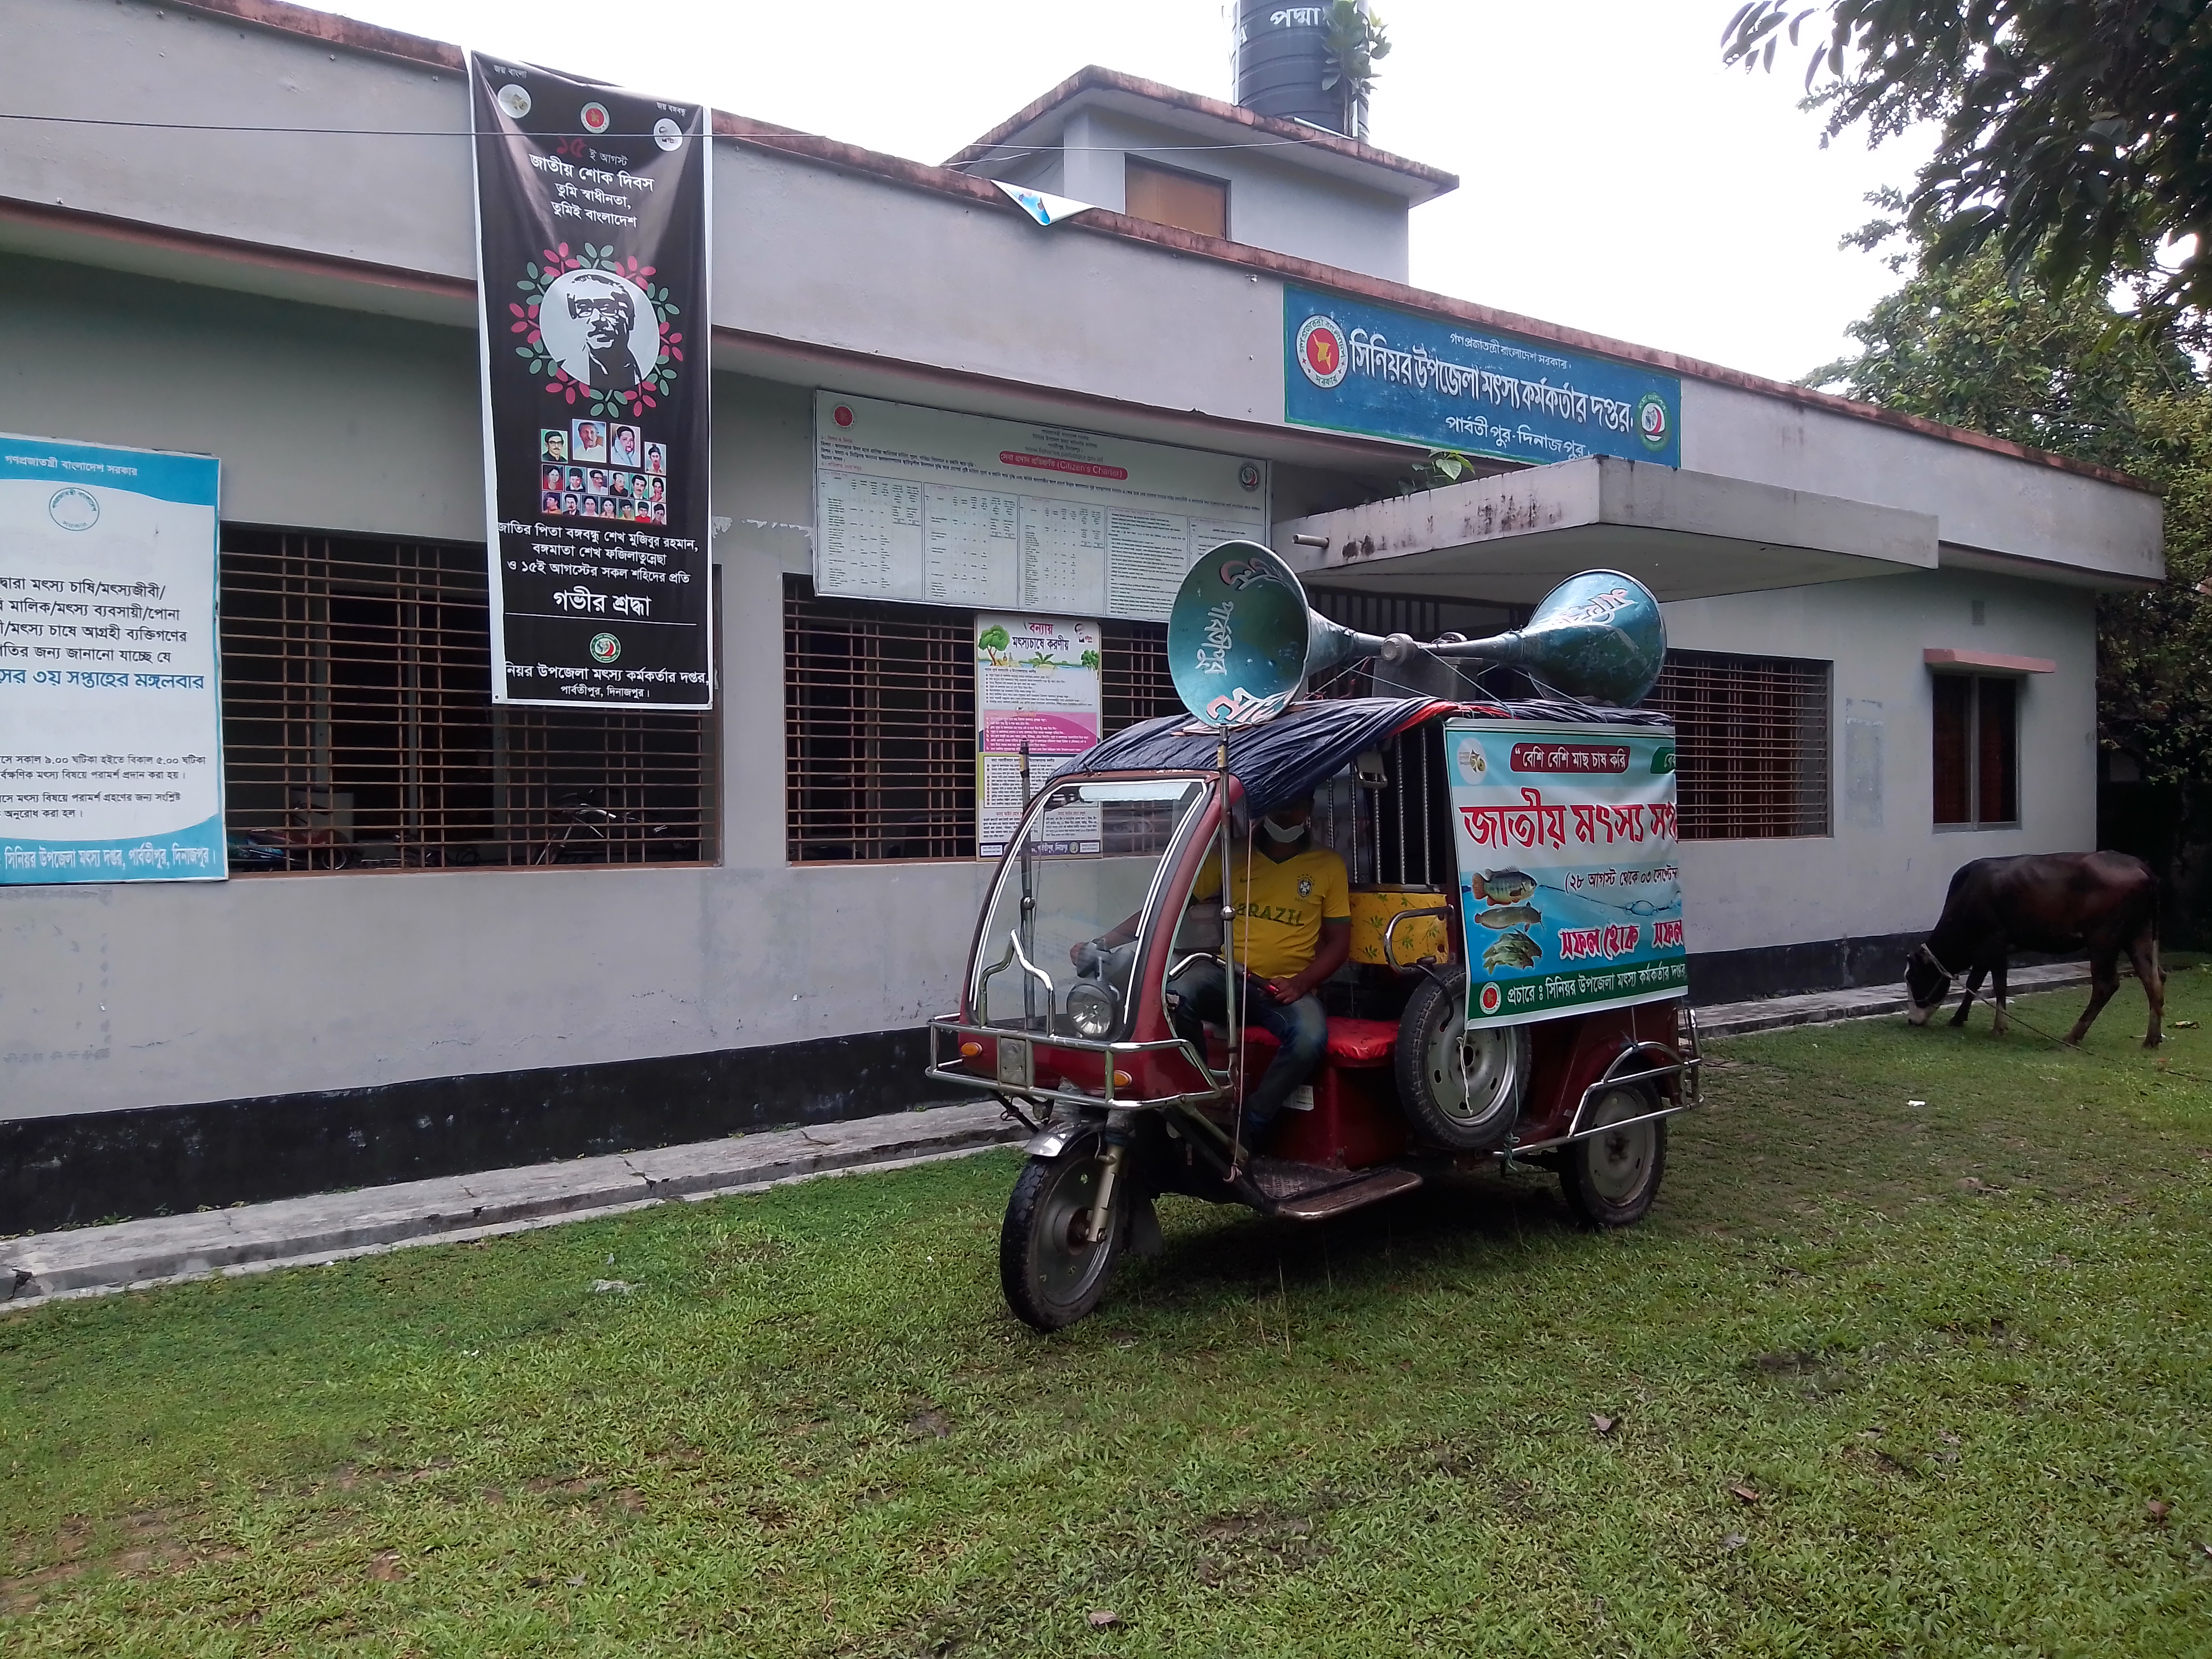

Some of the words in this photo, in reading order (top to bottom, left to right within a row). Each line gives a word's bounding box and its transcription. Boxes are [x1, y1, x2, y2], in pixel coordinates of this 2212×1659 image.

[1270, 6, 1322, 28] পদ্মা
[600, 152, 628, 166] আগস্ট
[529, 154, 574, 178] জাতীয়
[579, 168, 614, 186] শোক
[617, 171, 654, 191] দিবস
[555, 182, 578, 198] তুমি
[582, 188, 632, 210] স্বাধীনতা,
[551, 200, 582, 219] তুমিই
[584, 210, 638, 228] বাংলাদেশ
[1349, 328, 1413, 386] সিনিয়র
[1412, 343, 1480, 401] উপজেলা
[1482, 370, 1520, 409] মৎস্য
[1520, 376, 1589, 424] কর্মকর্তার
[61, 460, 104, 472] বাংলাদেশ
[107, 465, 138, 476] সরকার
[498, 520, 532, 534] জাতির
[534, 524, 563, 540] পিতা
[566, 528, 600, 543] বঙ্গবন্ধু
[605, 531, 626, 542] শেখ
[629, 532, 660, 548] মুজিবুর
[664, 538, 698, 552] রহমান,
[532, 543, 575, 557] বঙ্গমাতা
[580, 547, 602, 558] শেখ
[507, 561, 517, 571] ও
[522, 560, 547, 574] ১৫ই
[549, 563, 598, 576] আগস্টের
[602, 568, 628, 579] সকল
[631, 568, 665, 583] শহিদের
[669, 571, 691, 585] প্রতি
[30, 579, 65, 593] মৎস্য
[554, 586, 608, 613] গভীর
[613, 593, 651, 617] শ্রদ্ধা
[47, 624, 77, 637] চাষে
[82, 623, 121, 640] আগ্রহী
[1029, 622, 1054, 635] বন্যায়
[32, 647, 61, 659] জন্য
[64, 647, 115, 661] জানানো
[119, 650, 153, 665] যাচ্ছে
[157, 652, 172, 664] যে
[33, 671, 62, 686] ৩য়
[66, 671, 129, 689] সপ্তাহের
[134, 673, 205, 689] মঙ্গলবার
[538, 663, 589, 680] উপজেলা
[593, 669, 623, 682] মৎস্য
[626, 667, 676, 683] কর্মকর্তার
[680, 672, 709, 685] দপ্তর,
[560, 685, 603, 699] পার্বতীপুর,
[1548, 747, 1569, 768] বেশি
[1572, 752, 1589, 769] মাছ
[1591, 752, 1607, 768] চাষ
[1610, 748, 1627, 768] করি
[1458, 787, 1566, 850] জাতীয়
[1570, 803, 1645, 844] মৎস্য
[1588, 868, 1616, 888] আগস্ট
[1620, 870, 1639, 886] থেকে
[1559, 926, 1602, 960] সফল
[1604, 924, 1639, 960] হোক
[1507, 984, 1536, 1006] প্রচারে
[1545, 976, 1577, 999] সিনিয়র
[1578, 973, 1615, 994] উপজেলা
[1618, 974, 1637, 988] মৎস্য
